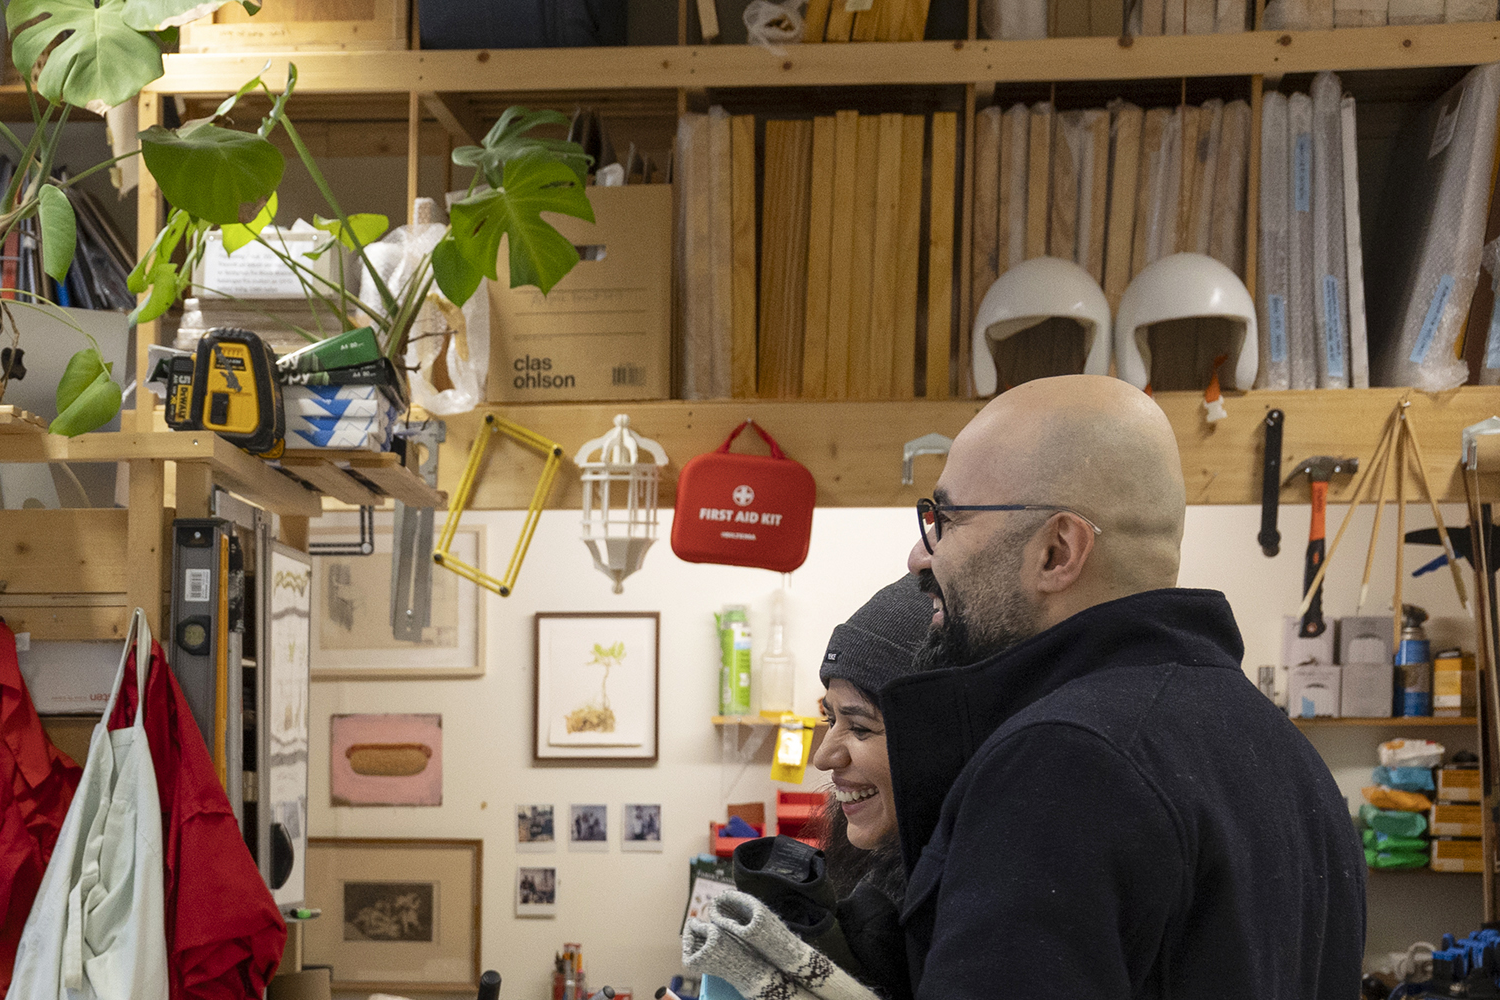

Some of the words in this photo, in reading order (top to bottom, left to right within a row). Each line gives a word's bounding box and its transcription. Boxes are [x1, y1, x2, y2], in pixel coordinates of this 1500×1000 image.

[513, 354, 553, 371] clas
[513, 371, 576, 390] ohlson
[699, 507, 734, 522] FIRST
[734, 510, 760, 524] AID
[760, 512, 783, 526] KIT
